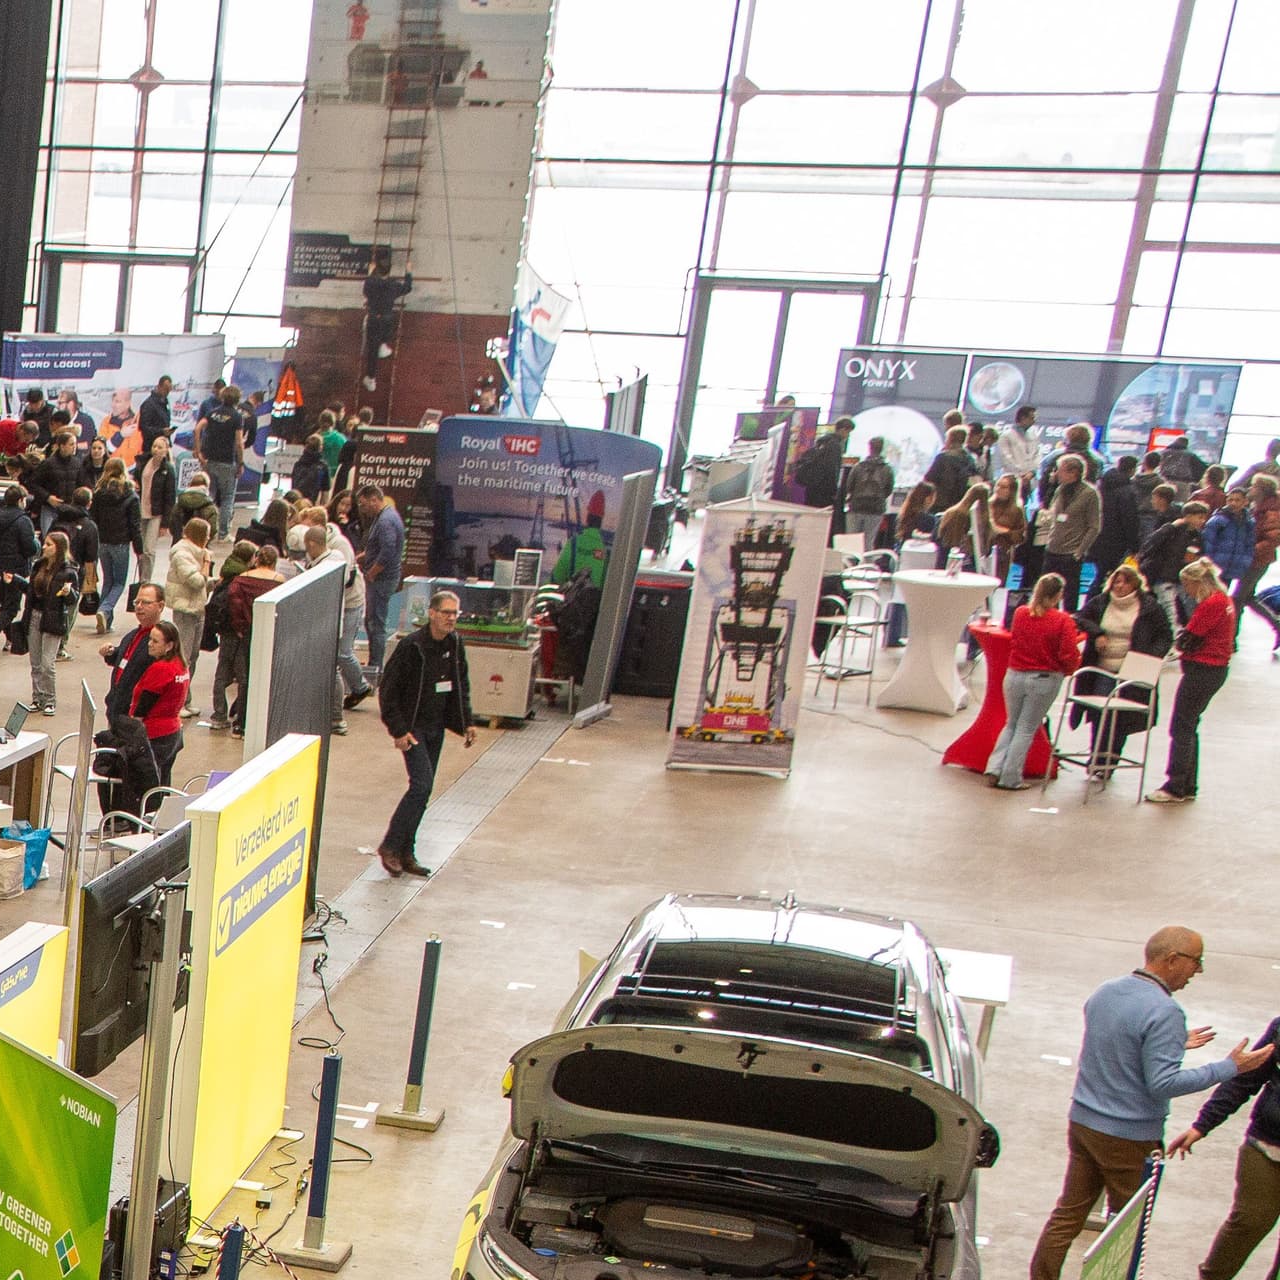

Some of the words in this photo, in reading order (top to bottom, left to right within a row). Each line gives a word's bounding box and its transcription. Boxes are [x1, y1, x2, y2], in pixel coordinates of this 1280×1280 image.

[843, 355, 918, 381] ONYX
[460, 436, 502, 451] Royal
[510, 439, 538, 453] IHC
[359, 466, 373, 475] en
[375, 465, 405, 477] leren
[407, 466, 424, 479] bij
[360, 454, 386, 465] Kom
[388, 456, 432, 467] werken
[457, 457, 489, 471] Join
[491, 459, 511, 472] us!
[514, 460, 571, 480] Together
[358, 475, 390, 488] Royal
[457, 474, 480, 487] the
[482, 476, 543, 493] maritime
[543, 484, 580, 498] future
[234, 802, 282, 867] Verzekerd
[282, 795, 300, 828] van
[231, 884, 269, 927] nieuwe
[268, 839, 302, 887] energie
[66, 1096, 102, 1130] NOBIAN
[5, 1195, 52, 1238] GREENER
